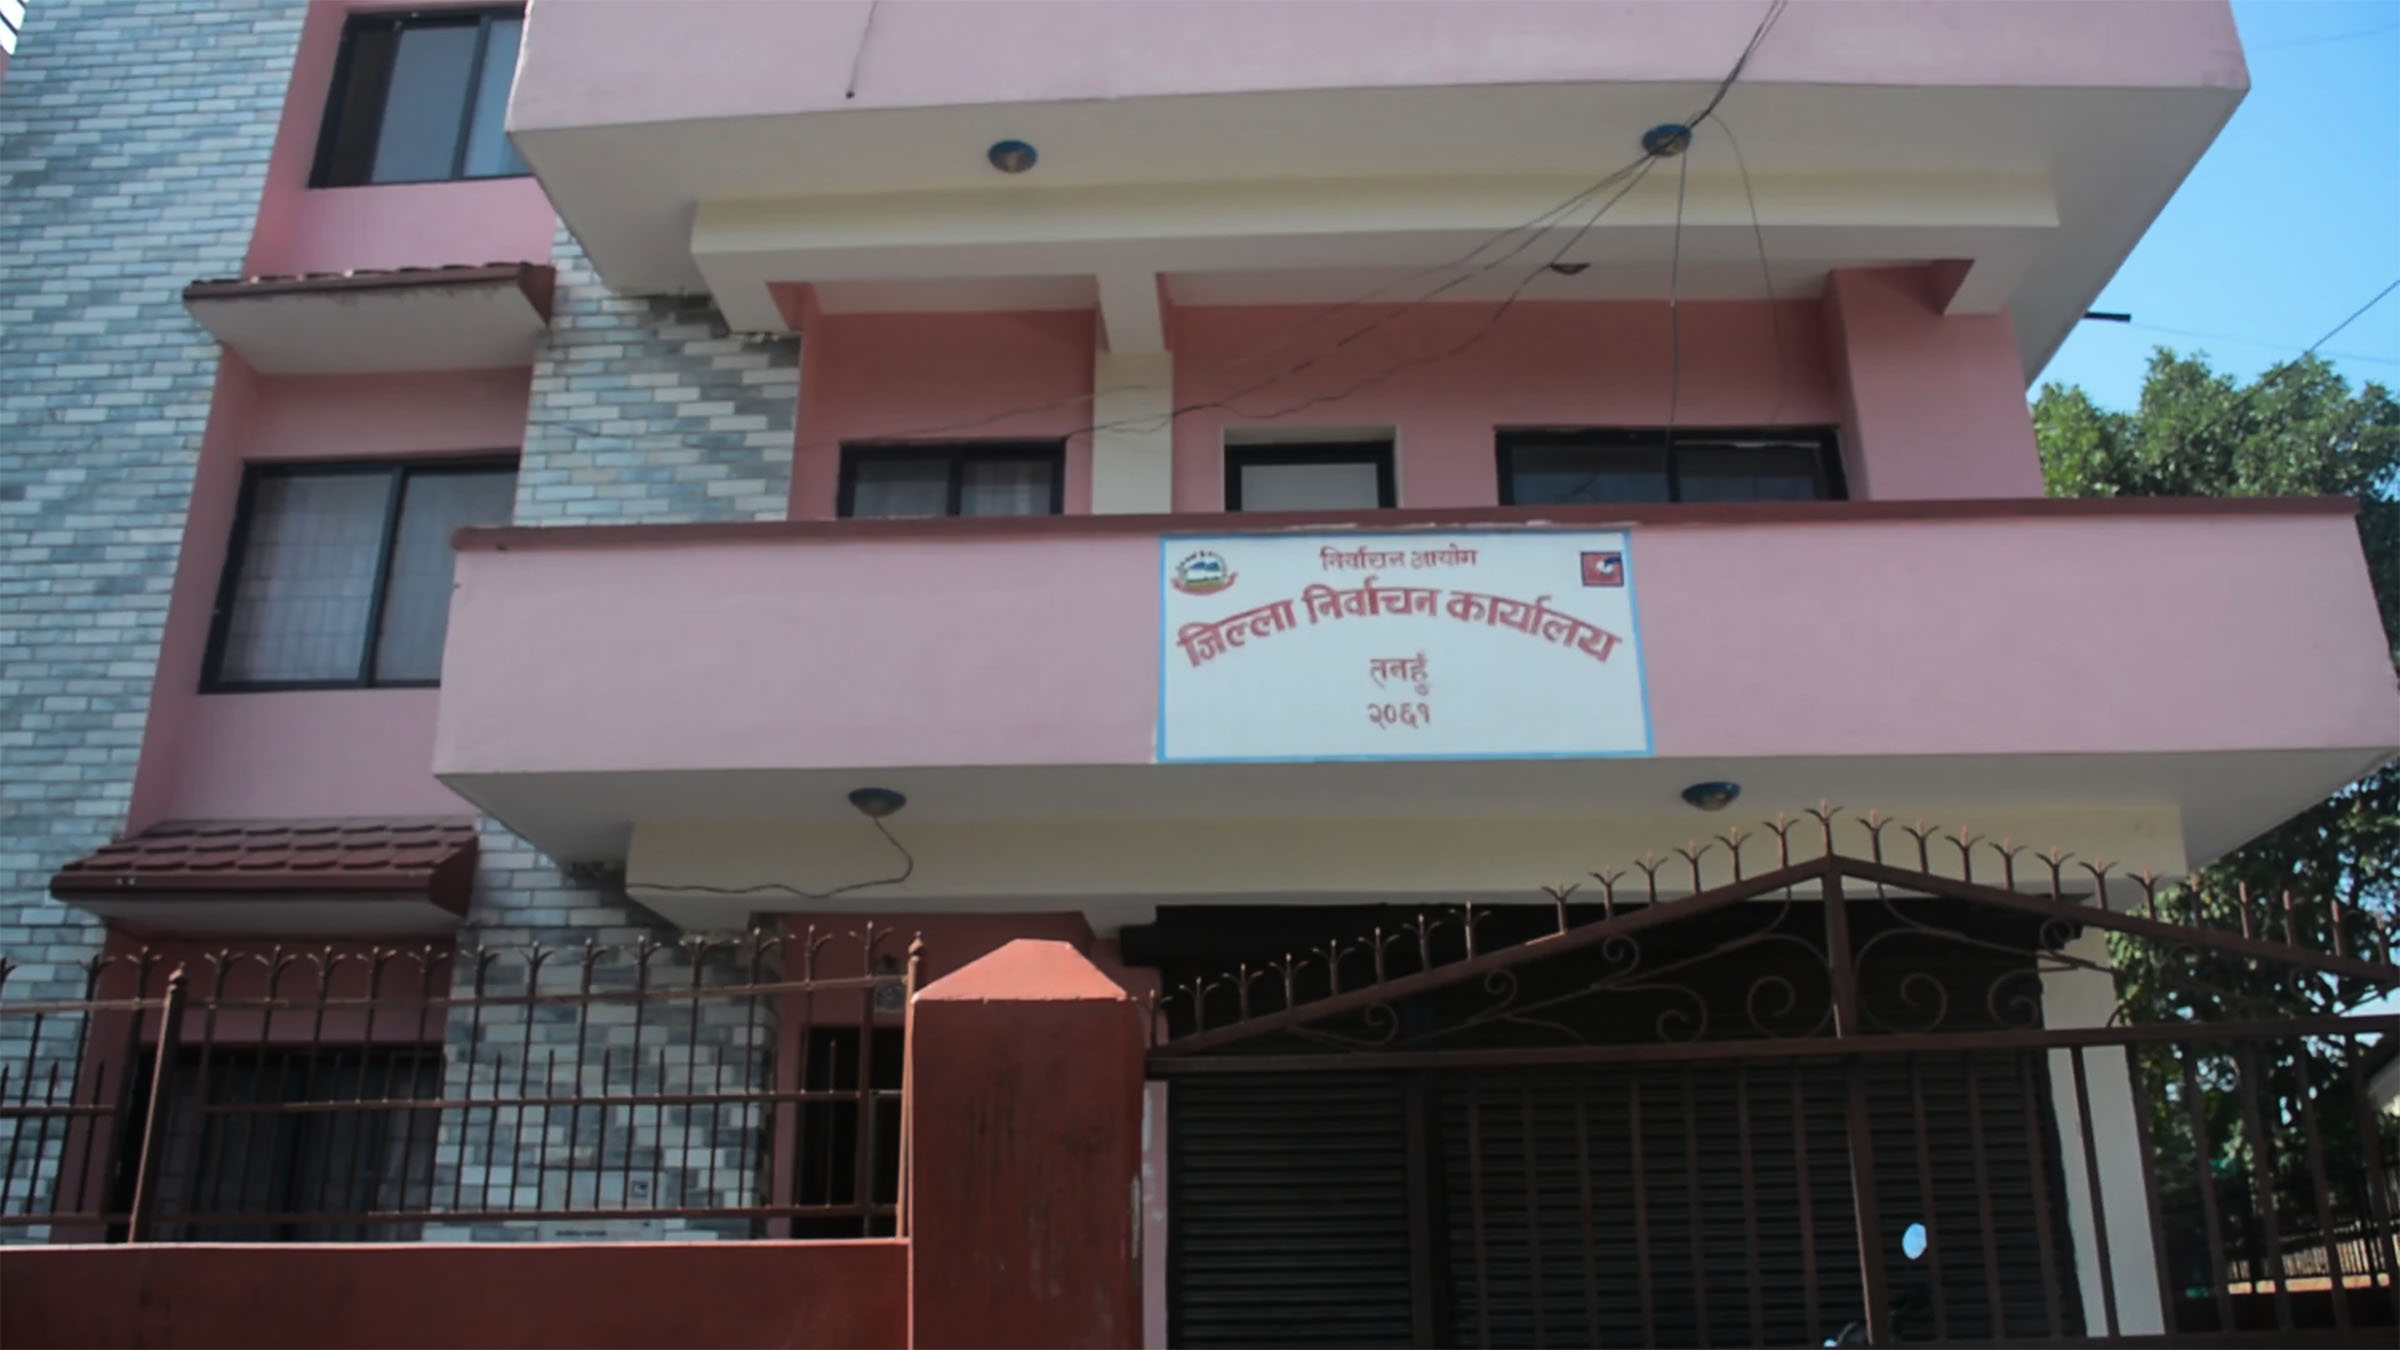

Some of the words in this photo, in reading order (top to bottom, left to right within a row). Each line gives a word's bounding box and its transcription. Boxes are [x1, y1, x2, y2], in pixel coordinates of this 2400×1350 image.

[1320, 545, 1405, 571] निर्वाचन
[1411, 543, 1477, 569] आयोग
[1177, 598, 1297, 667] जिल्ला
[1301, 575, 1441, 625] निर्वाचन
[1446, 590, 1623, 663] कार्यालय
[1367, 702, 1430, 730] २०६१
